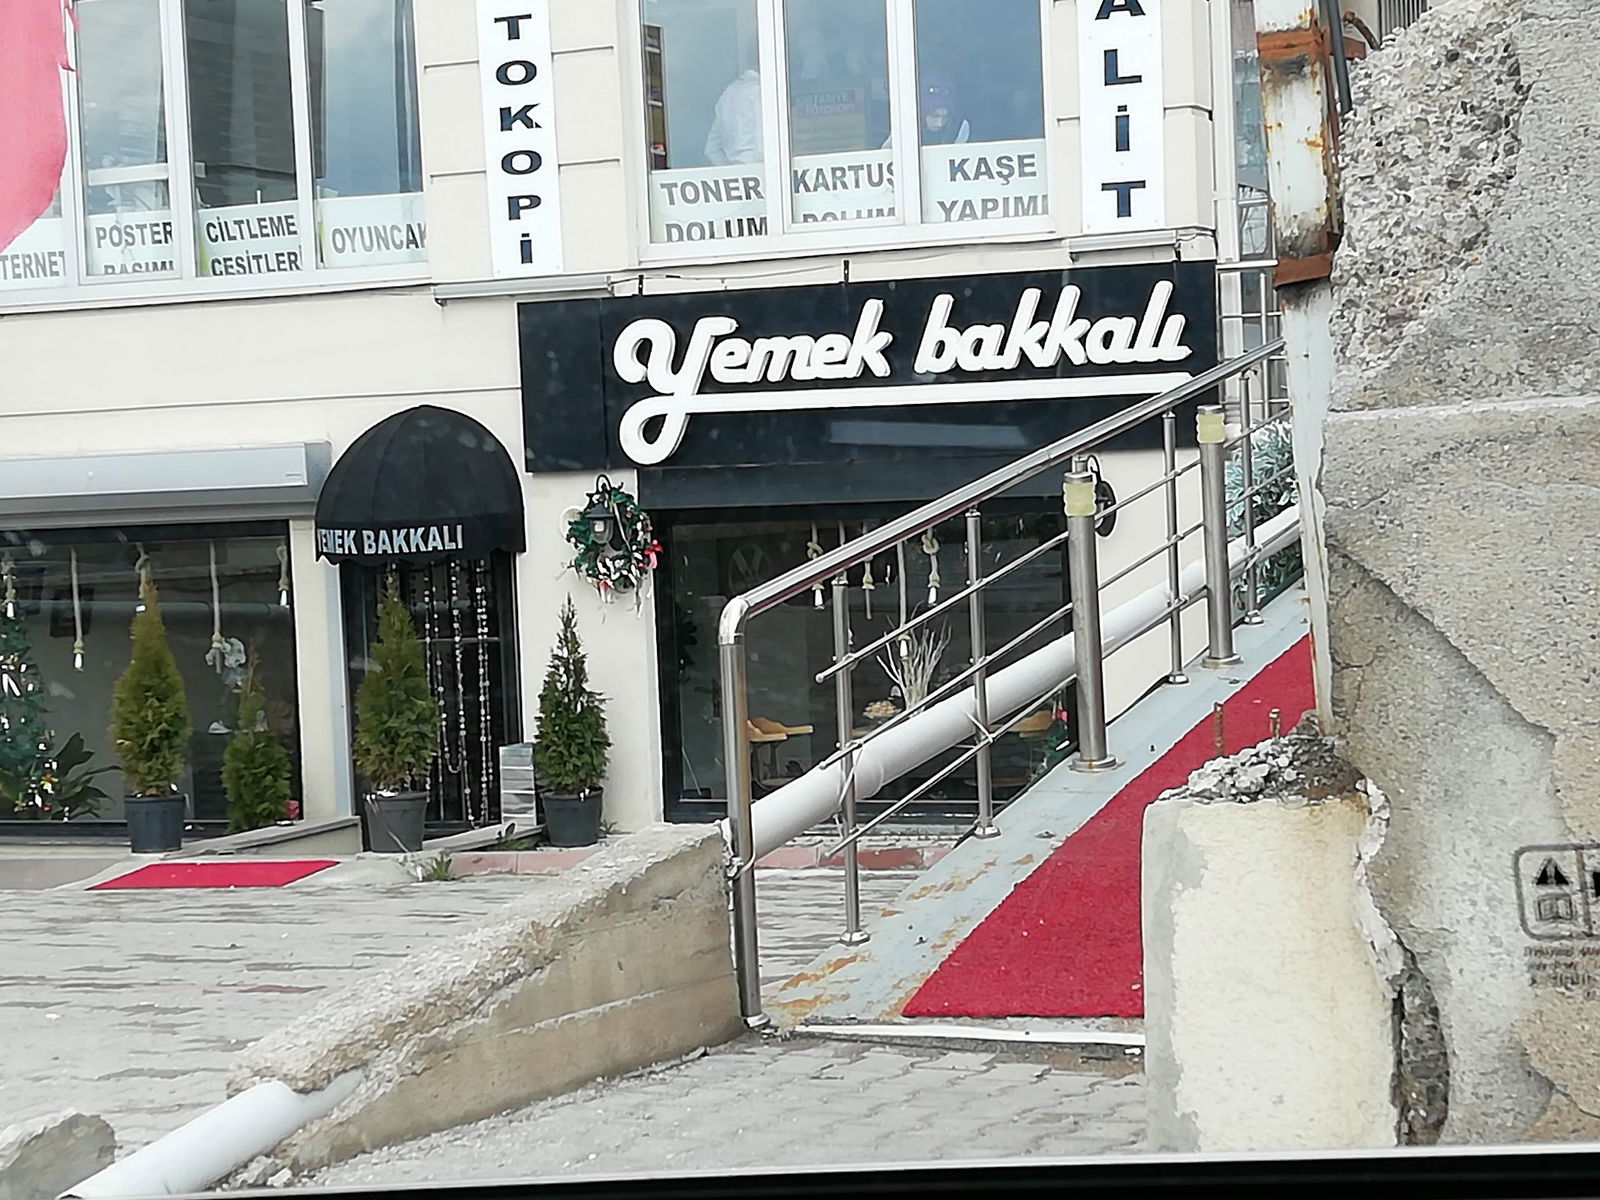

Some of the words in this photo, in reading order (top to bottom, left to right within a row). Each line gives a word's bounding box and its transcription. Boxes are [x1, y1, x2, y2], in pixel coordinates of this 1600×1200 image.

[948, 153, 1037, 186] KAŞE
[660, 176, 765, 206] TONER
[937, 194, 1049, 222] YAPIMI
[95, 221, 173, 249] POSTER
[205, 214, 298, 243] CİLTLEME
[665, 217, 768, 243] DOLUM
[613, 298, 893, 466] Yemek
[913, 280, 1193, 375] bakkalı
[362, 525, 463, 555] BAKKALI
